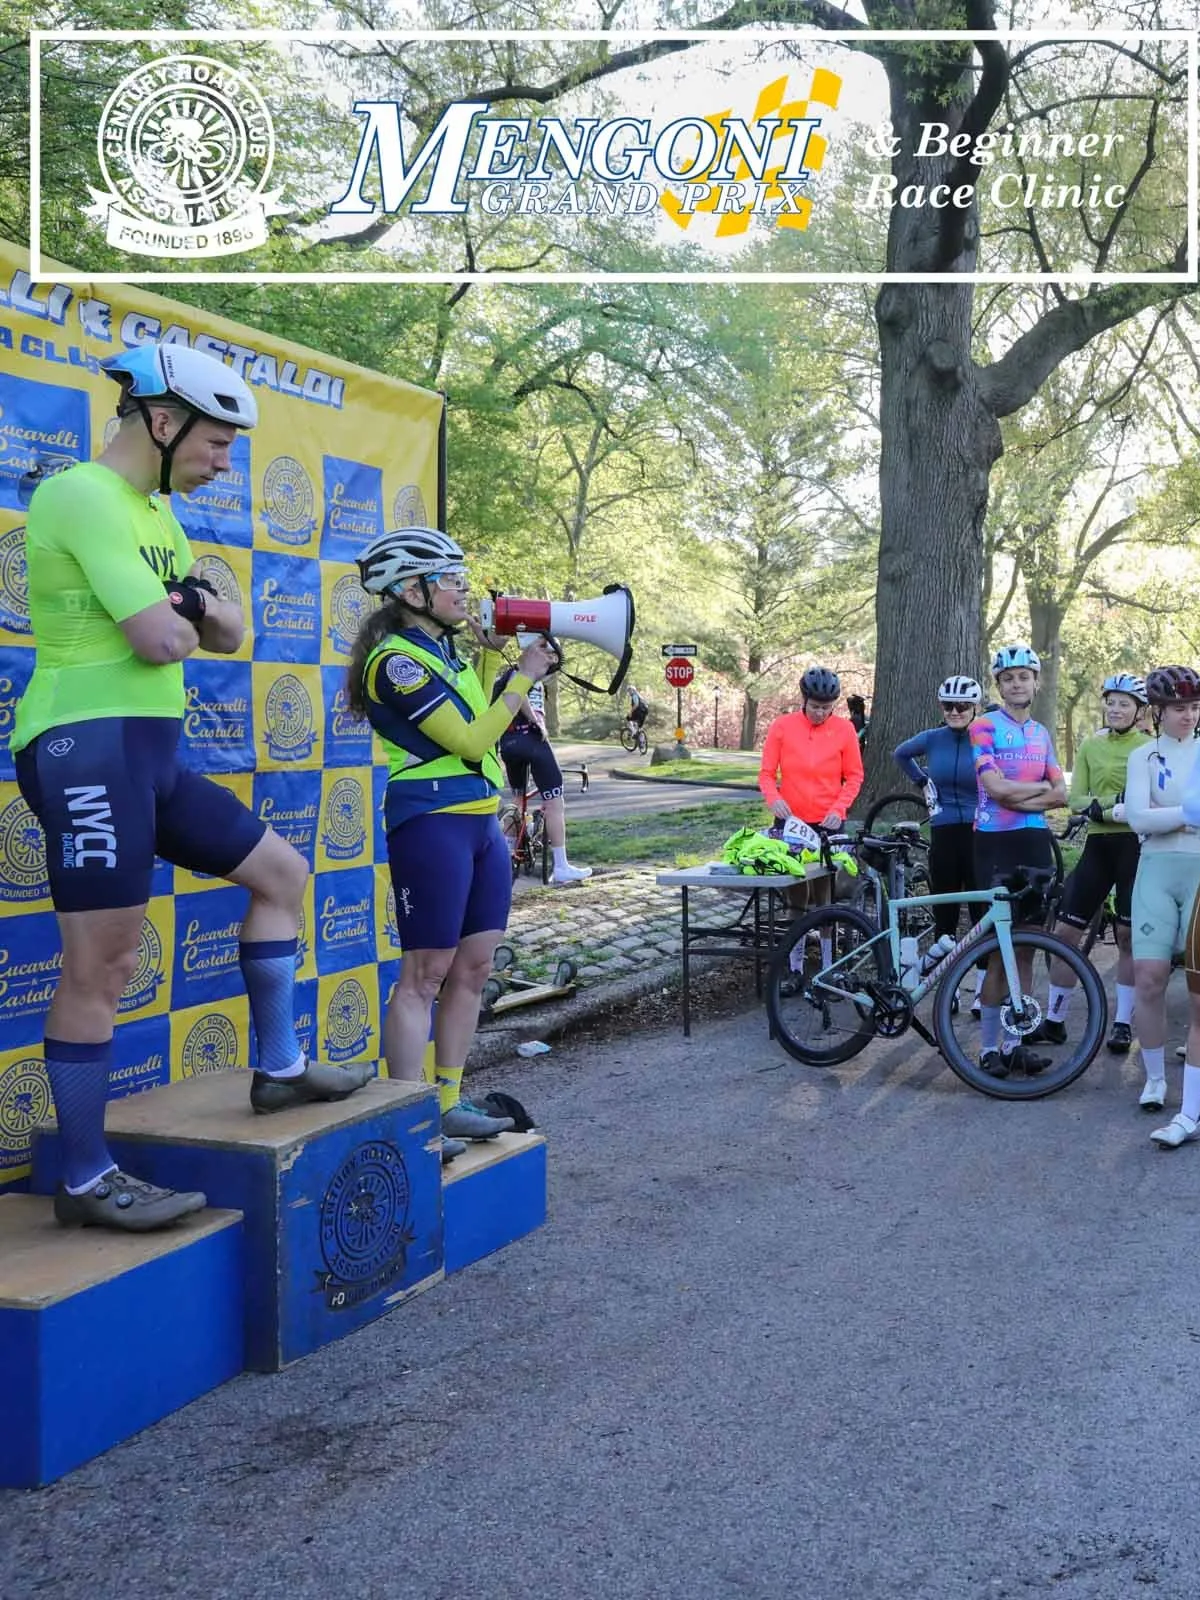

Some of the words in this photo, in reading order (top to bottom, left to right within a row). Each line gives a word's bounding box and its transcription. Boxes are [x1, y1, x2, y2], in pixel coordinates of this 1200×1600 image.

[574, 614, 597, 623] PYLE
[666, 667, 693, 679] STOP
[185, 687, 248, 713] Lucarelli
[183, 712, 246, 738] Castaldi
[258, 797, 318, 822] Lucarelli
[64, 785, 117, 869] NYCC
[60, 832, 74, 869] RACING
[320, 896, 371, 919] Lucarelli
[181, 919, 242, 946] Lucarelli
[322, 918, 369, 942] Castaldi
[0, 949, 65, 978] ucarell
[108, 1055, 163, 1082] ucarelli
[361, 1149, 392, 1163] ROAD
